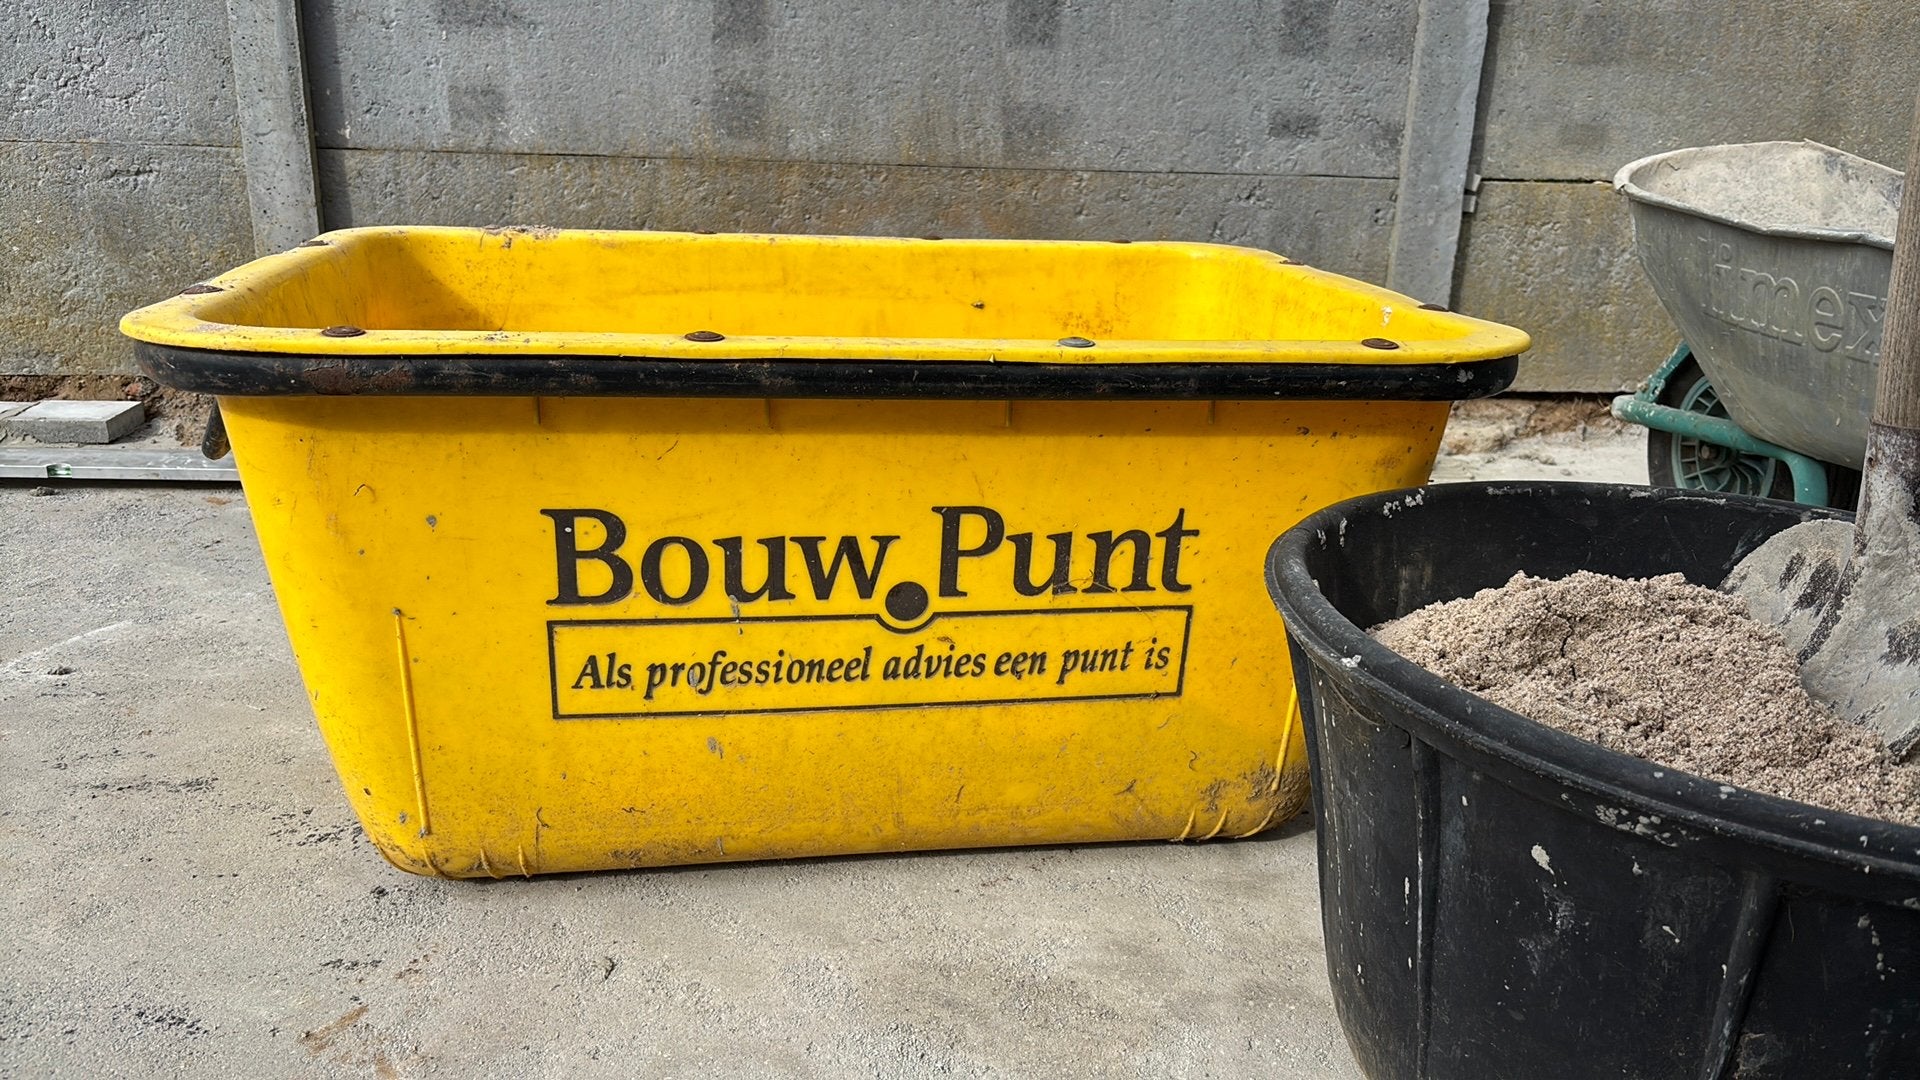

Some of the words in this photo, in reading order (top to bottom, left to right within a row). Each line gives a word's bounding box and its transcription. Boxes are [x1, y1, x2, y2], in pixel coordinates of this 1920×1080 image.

[572, 652, 632, 690] Als
[643, 646, 872, 701] professioneel
[882, 643, 986, 681] advies
[994, 650, 1049, 680] een
[1055, 641, 1134, 685] punt
[1144, 637, 1171, 671] is
